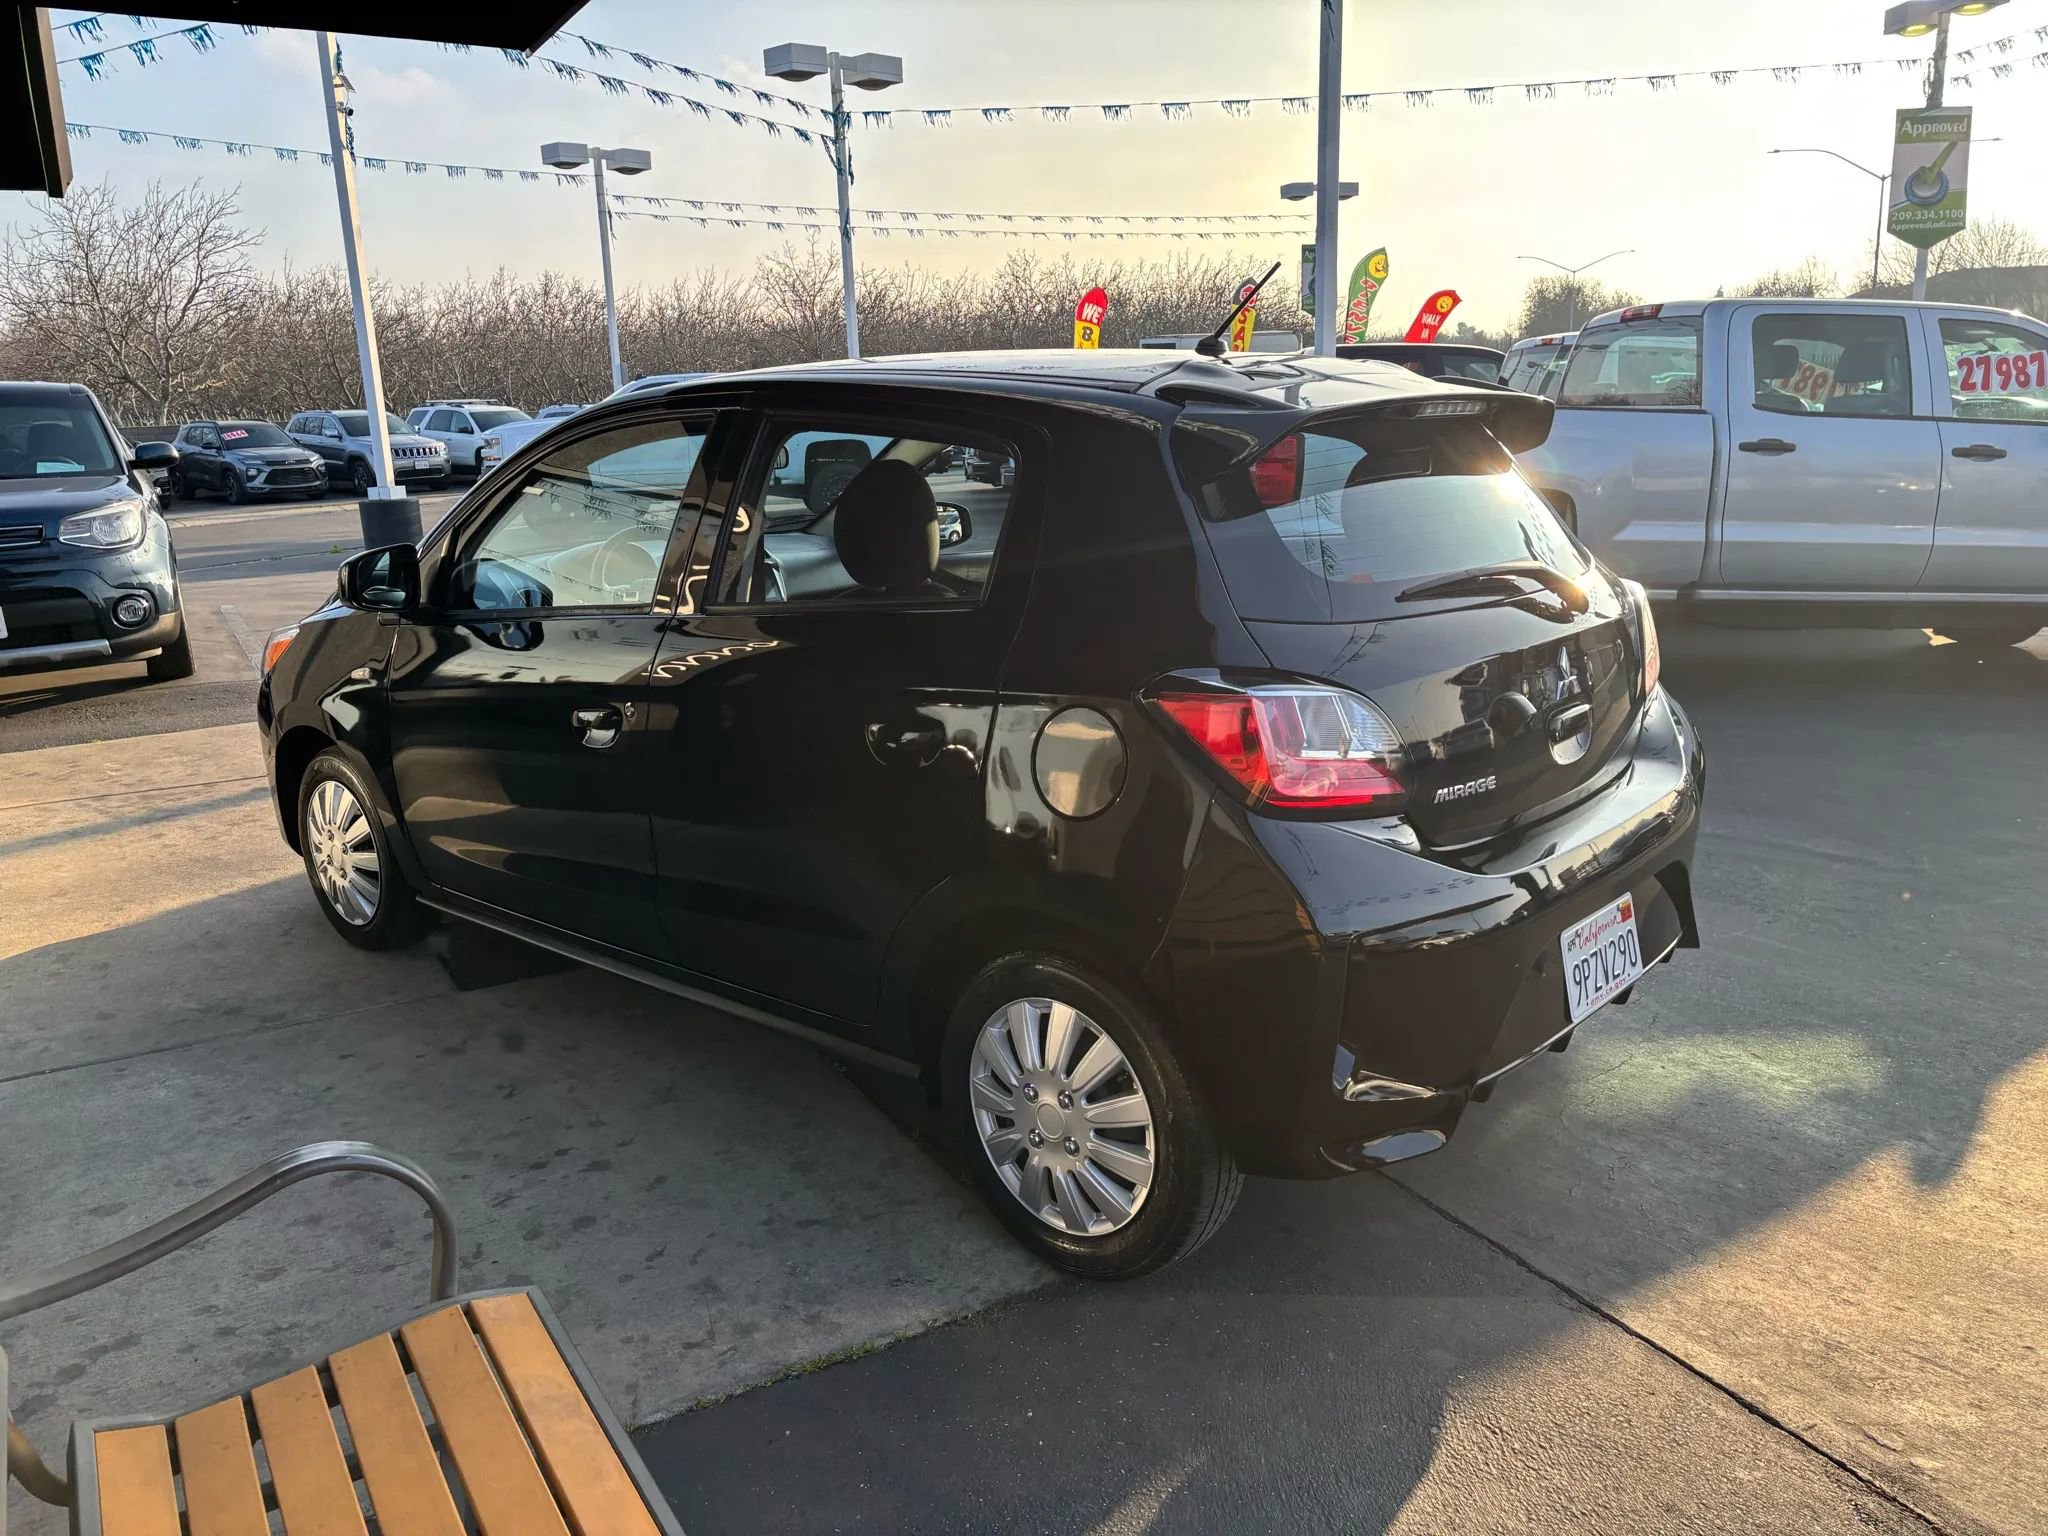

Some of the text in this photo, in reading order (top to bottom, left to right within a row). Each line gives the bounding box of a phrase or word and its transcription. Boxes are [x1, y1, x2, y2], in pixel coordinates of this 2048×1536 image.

[1900, 117, 1968, 137] Approved
[1892, 209, 1964, 220] 209.334.1100
[1081, 302, 1103, 324] WE
[1957, 351, 2045, 392] 27987
[1433, 775, 1497, 804] MIRAGE
[1572, 928, 1638, 1009] 9PZV290
